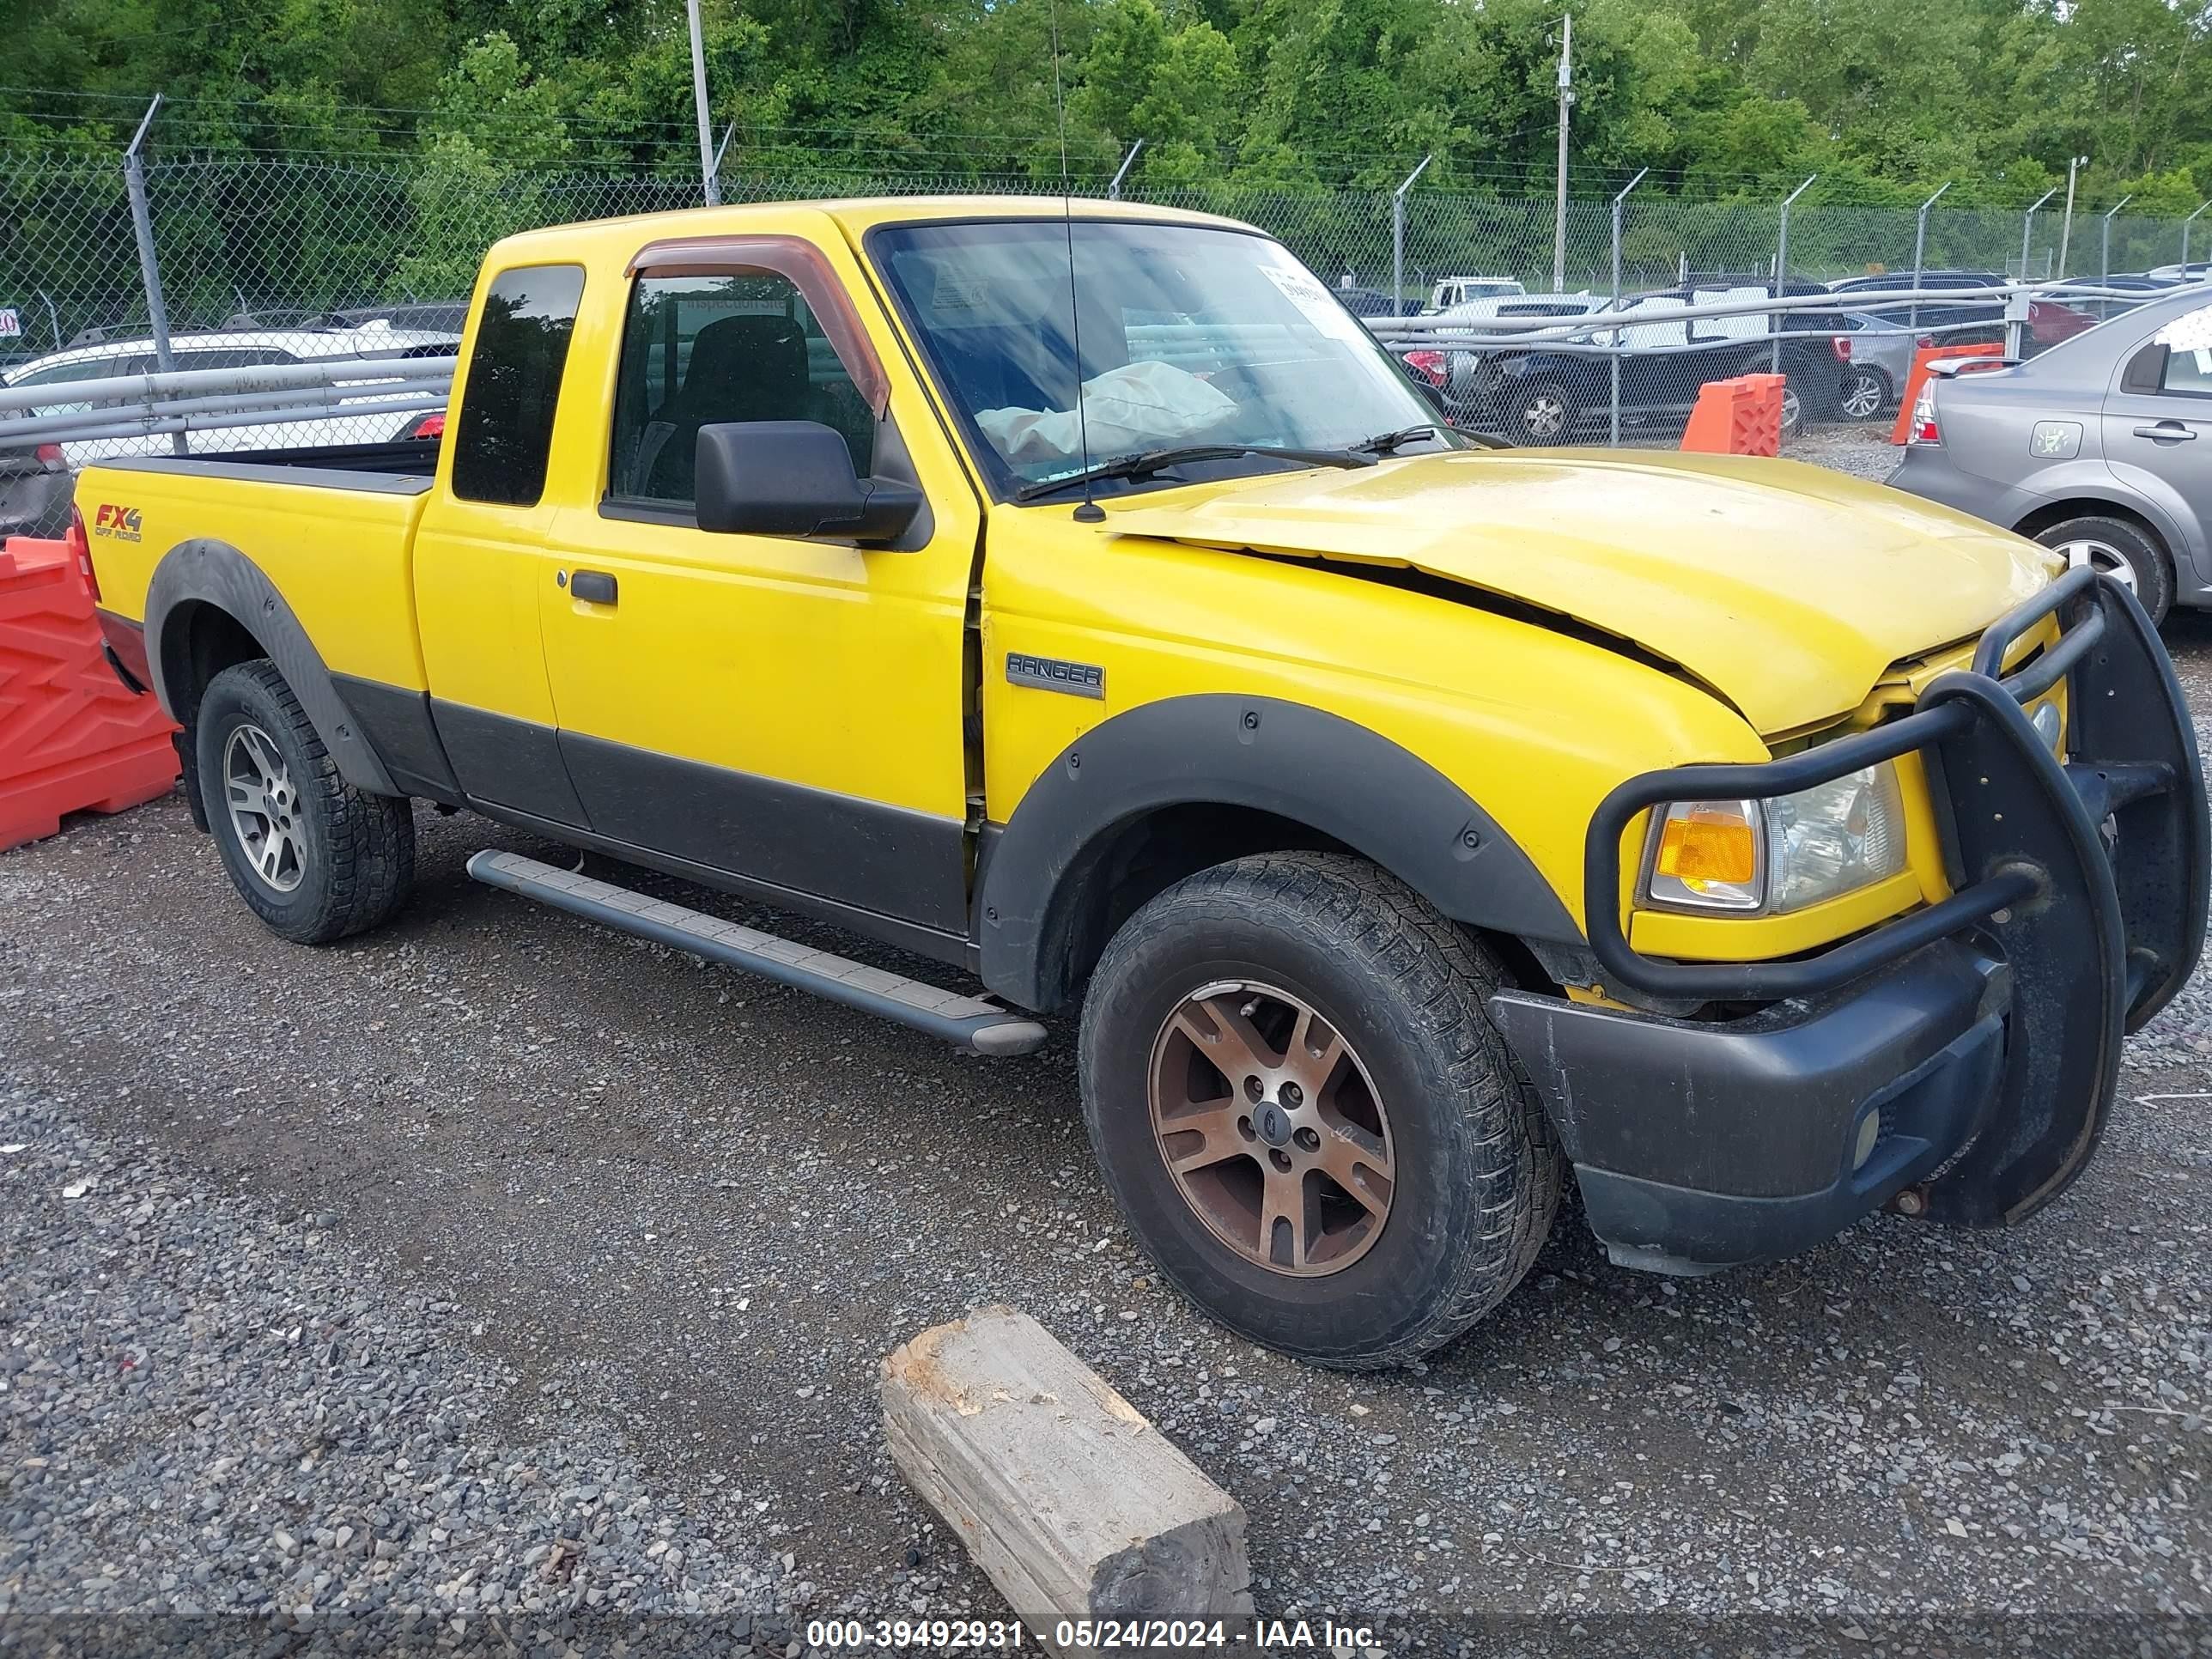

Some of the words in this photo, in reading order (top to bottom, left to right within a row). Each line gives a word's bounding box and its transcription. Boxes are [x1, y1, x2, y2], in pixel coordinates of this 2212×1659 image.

[96, 504, 143, 532] FX4
[96, 526, 112, 537] OFF
[115, 529, 142, 543] ROAD
[1007, 656, 1103, 686] RANGER
